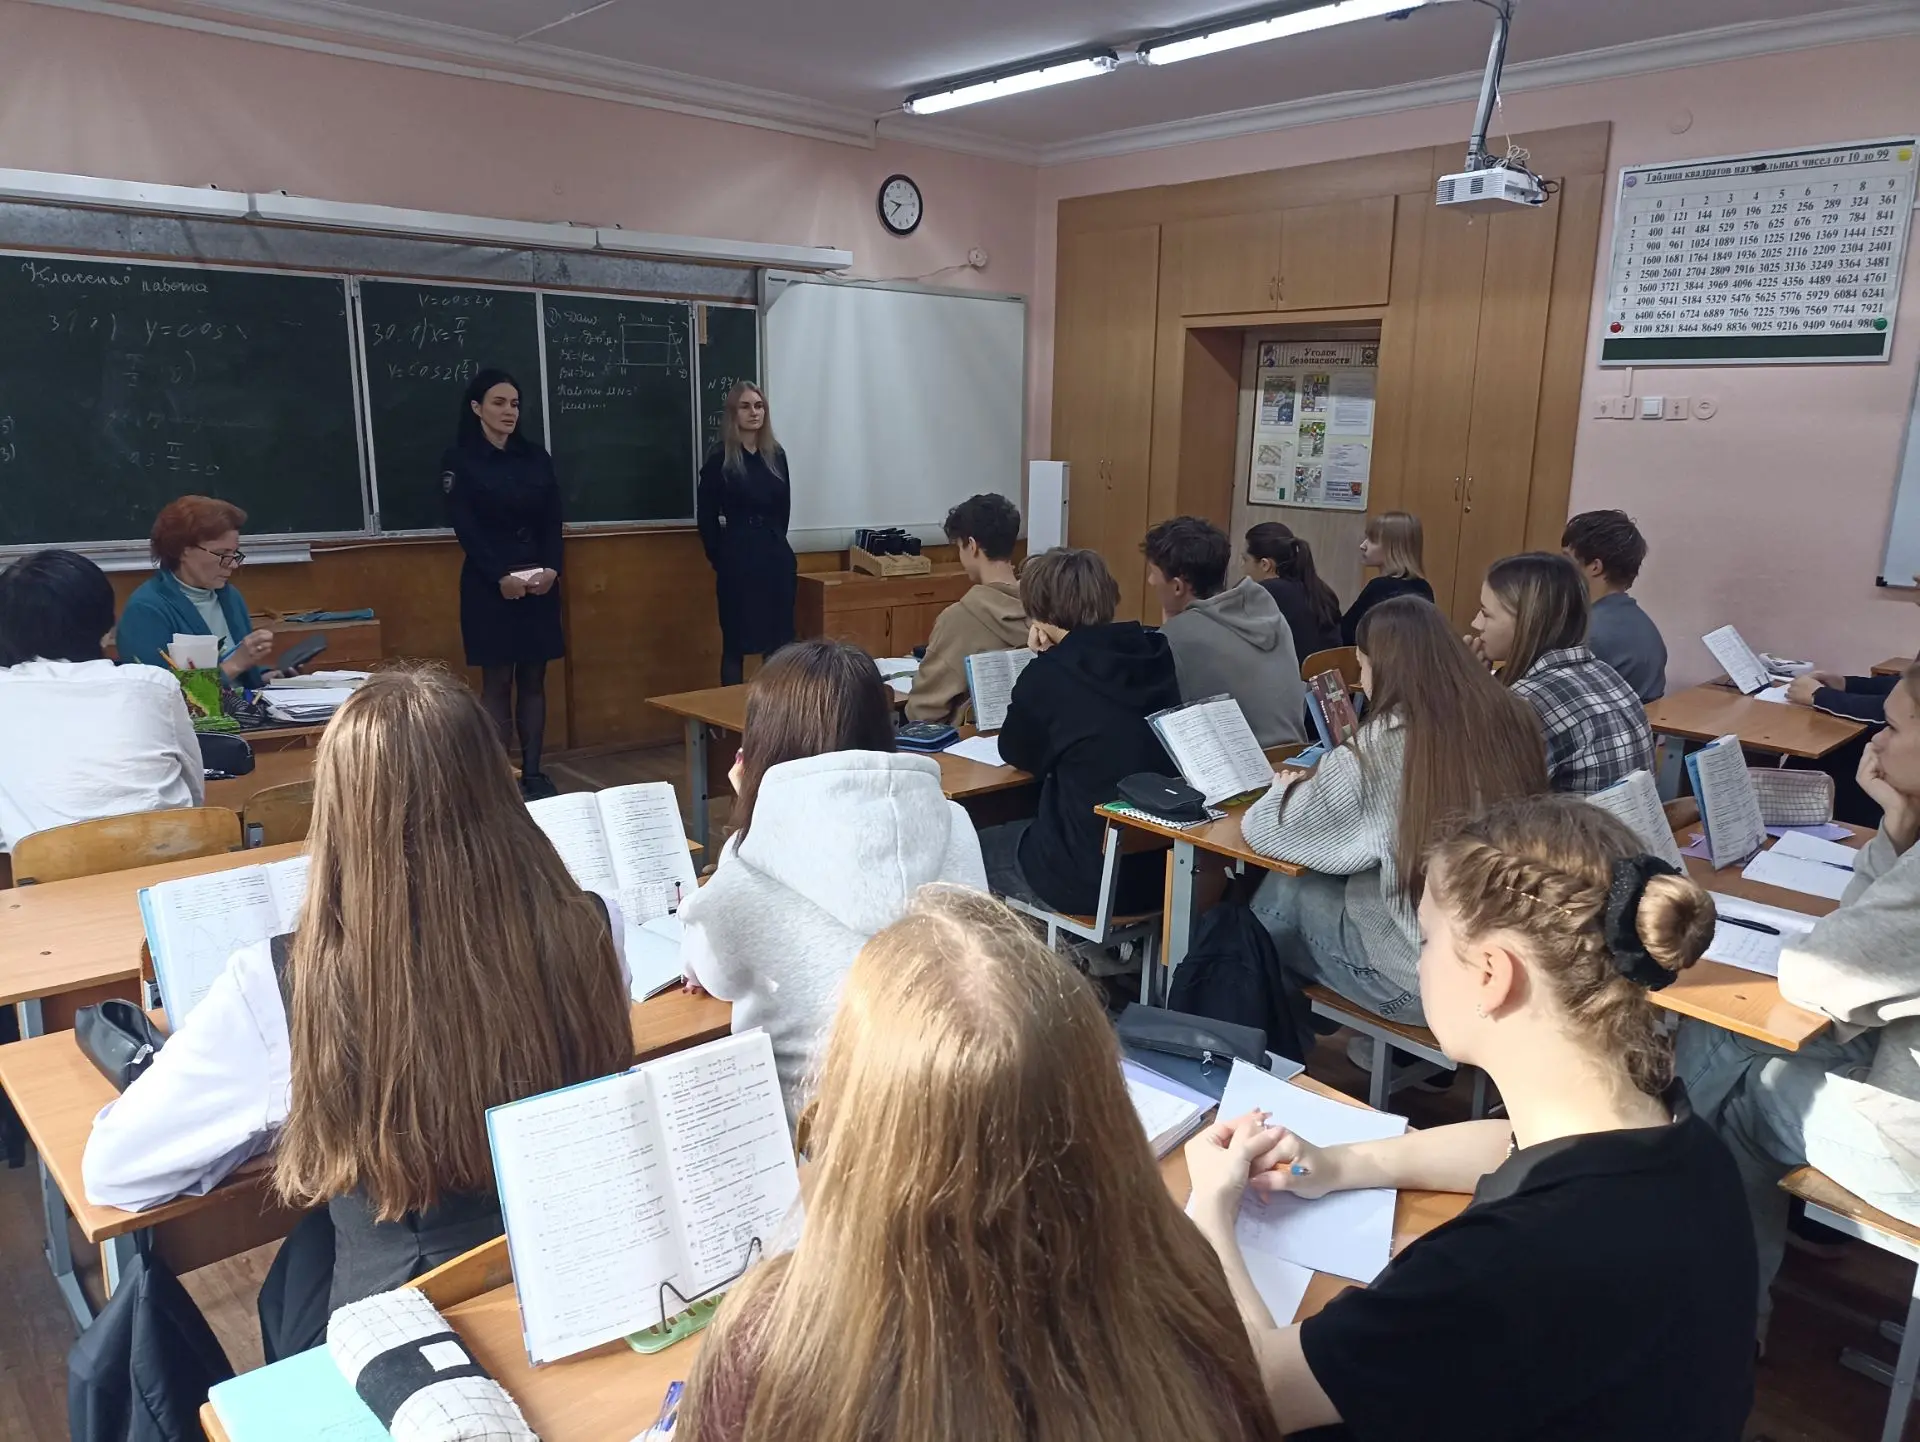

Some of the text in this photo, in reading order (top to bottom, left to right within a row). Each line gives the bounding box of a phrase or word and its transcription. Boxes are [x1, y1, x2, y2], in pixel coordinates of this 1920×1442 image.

[1646, 149, 1890, 182] Таблица квадратов натльных чисел от 10 до 99
[1656, 179, 1895, 208] 0 1 2 3 4 5 6 7 8 9
[1633, 194, 1897, 225] 1 100 121 144 169 196 225 256 289 324 361
[1631, 210, 1894, 238] 2 400 441 484 529 576 625 676 729 784 841
[1629, 226, 1895, 252] 3 900 961 1024 1089 1156 1225 1296 1369 1444 1521
[1627, 241, 1891, 265] 4 1600 1681 1764 1849 1936 2025 2116 2209 2304 2401
[1625, 257, 1889, 280] 5 2500 2601 2704 2809 2916 3025 3136 3249 3364 3481
[1623, 273, 1887, 293] 6 3600 3721 3844 3969 4096 4225 4356 4489 4624 4761
[1622, 288, 1884, 306] 7 4900 5041 5184 5329 5476 5625 5776 5929 6084 6241
[1620, 303, 1883, 320] 8 6400 6561 6724 6889 7056 7225 7396 7569 7744 7921
[1634, 318, 1875, 333] 8100 8281 8464 8649 8836 9025 9216 9409 9604 980
[1304, 348, 1337, 356] Уголок
